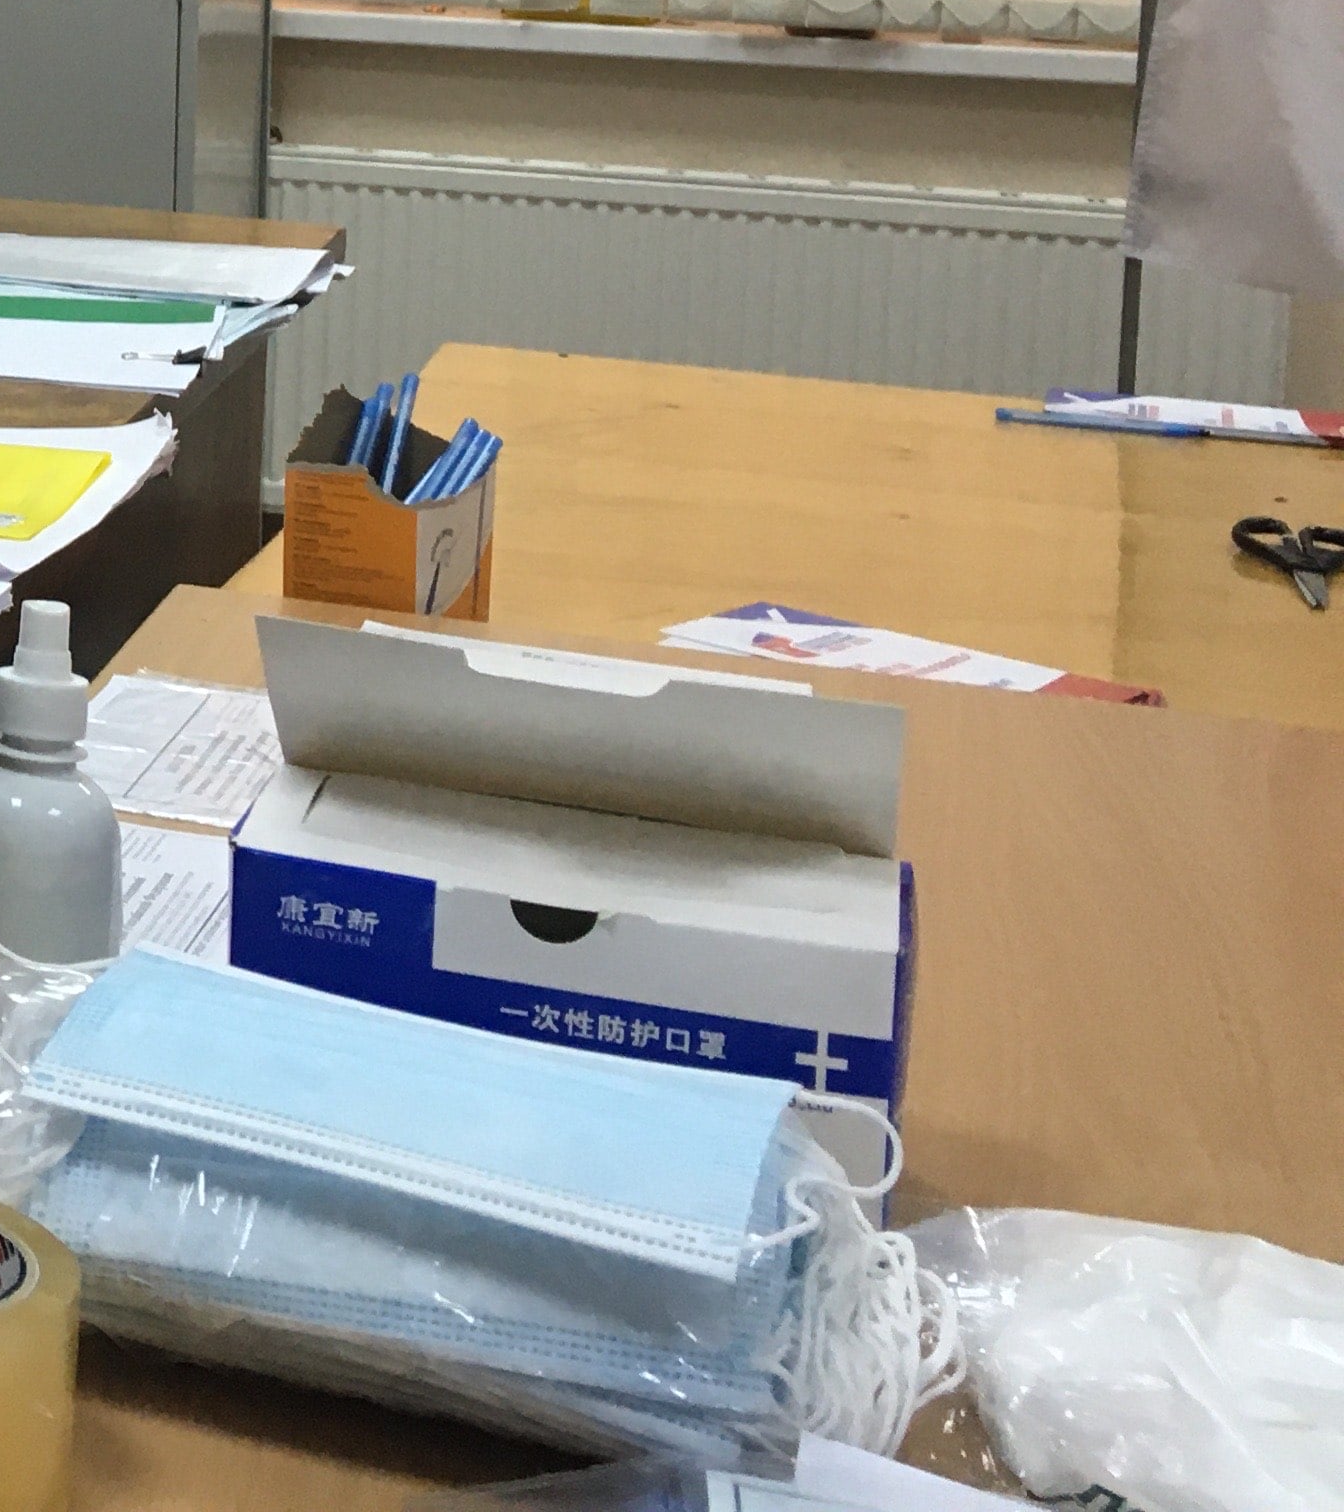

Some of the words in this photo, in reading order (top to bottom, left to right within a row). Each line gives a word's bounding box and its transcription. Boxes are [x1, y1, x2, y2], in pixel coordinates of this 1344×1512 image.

[277, 894, 380, 935] 康宜新
[281, 921, 372, 947] KANGYIXIN
[499, 1003, 728, 1061] 一次性防护口罩
